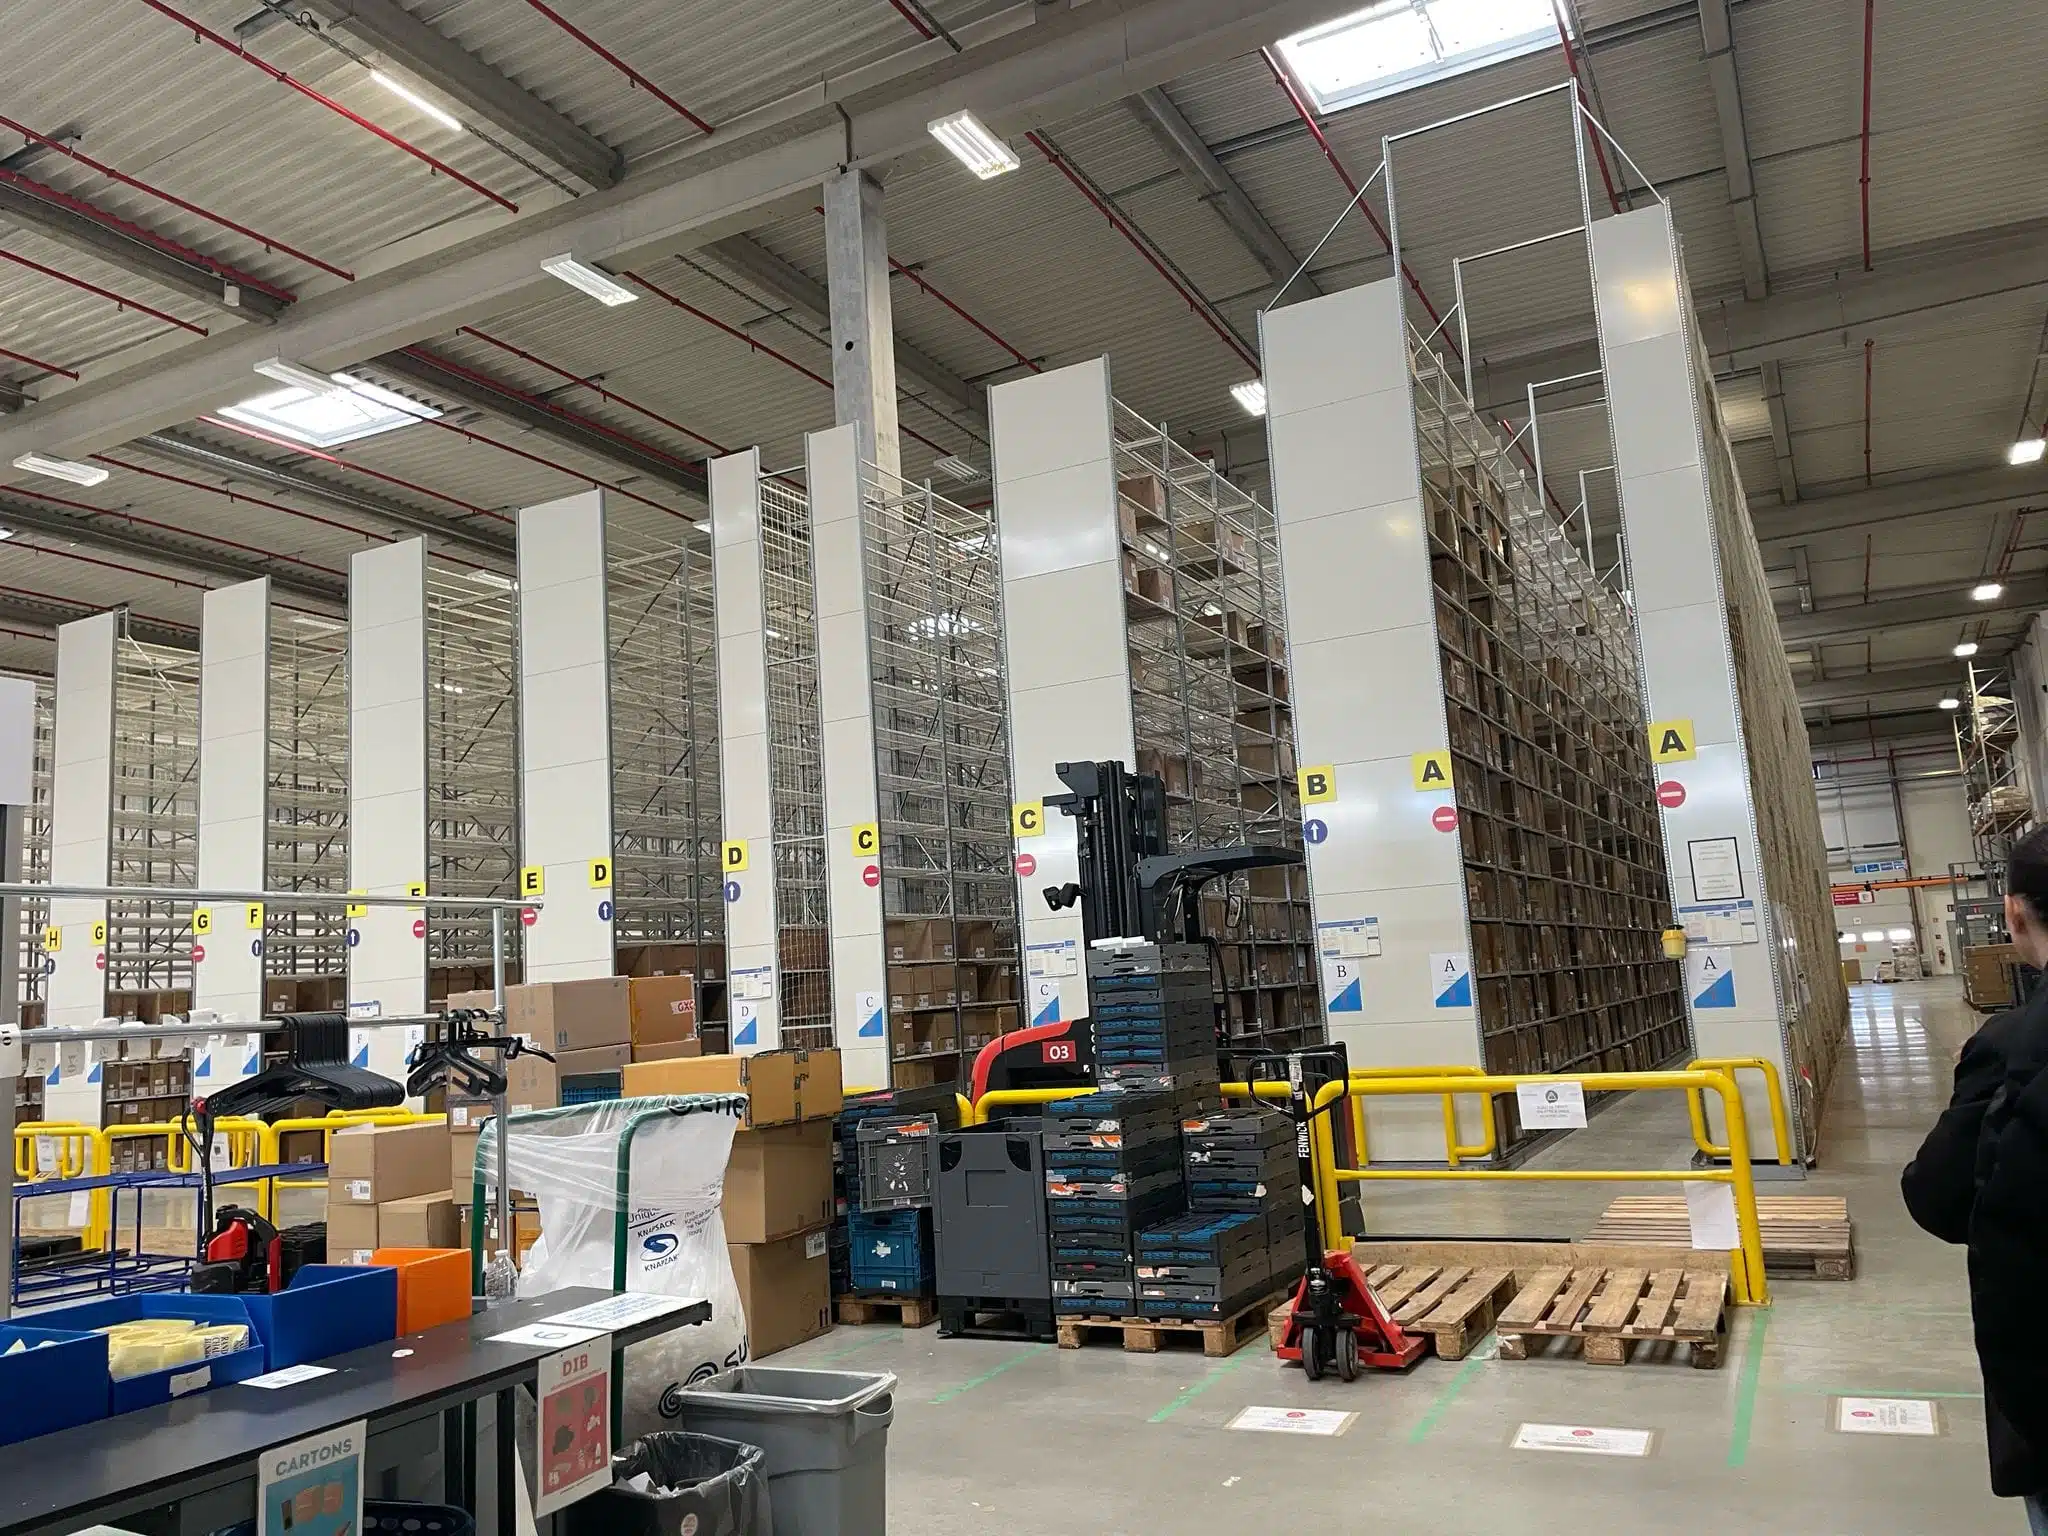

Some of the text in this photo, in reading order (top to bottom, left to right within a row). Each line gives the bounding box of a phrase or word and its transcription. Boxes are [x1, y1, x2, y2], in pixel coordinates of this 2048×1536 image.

[1660, 730, 1687, 754] A
[1422, 759, 1446, 783] A
[1307, 773, 1328, 796] B
[1020, 810, 1037, 830] C
[858, 830, 873, 849] C
[728, 847, 742, 865] D
[526, 872, 537, 889] E
[594, 864, 607, 881] D
[198, 914, 208, 929] G
[250, 909, 258, 924] F
[49, 930, 58, 947] H
[95, 925, 104, 940] G
[1444, 959, 1456, 972] A
[1702, 956, 1717, 970] A
[1336, 965, 1347, 979] B
[1040, 984, 1049, 996] C
[865, 996, 874, 1008] C
[741, 1005, 749, 1017] D
[1296, 1121, 1310, 1158] FENWICK
[563, 1353, 588, 1376] DIB
[275, 1438, 352, 1477] CARTONS
